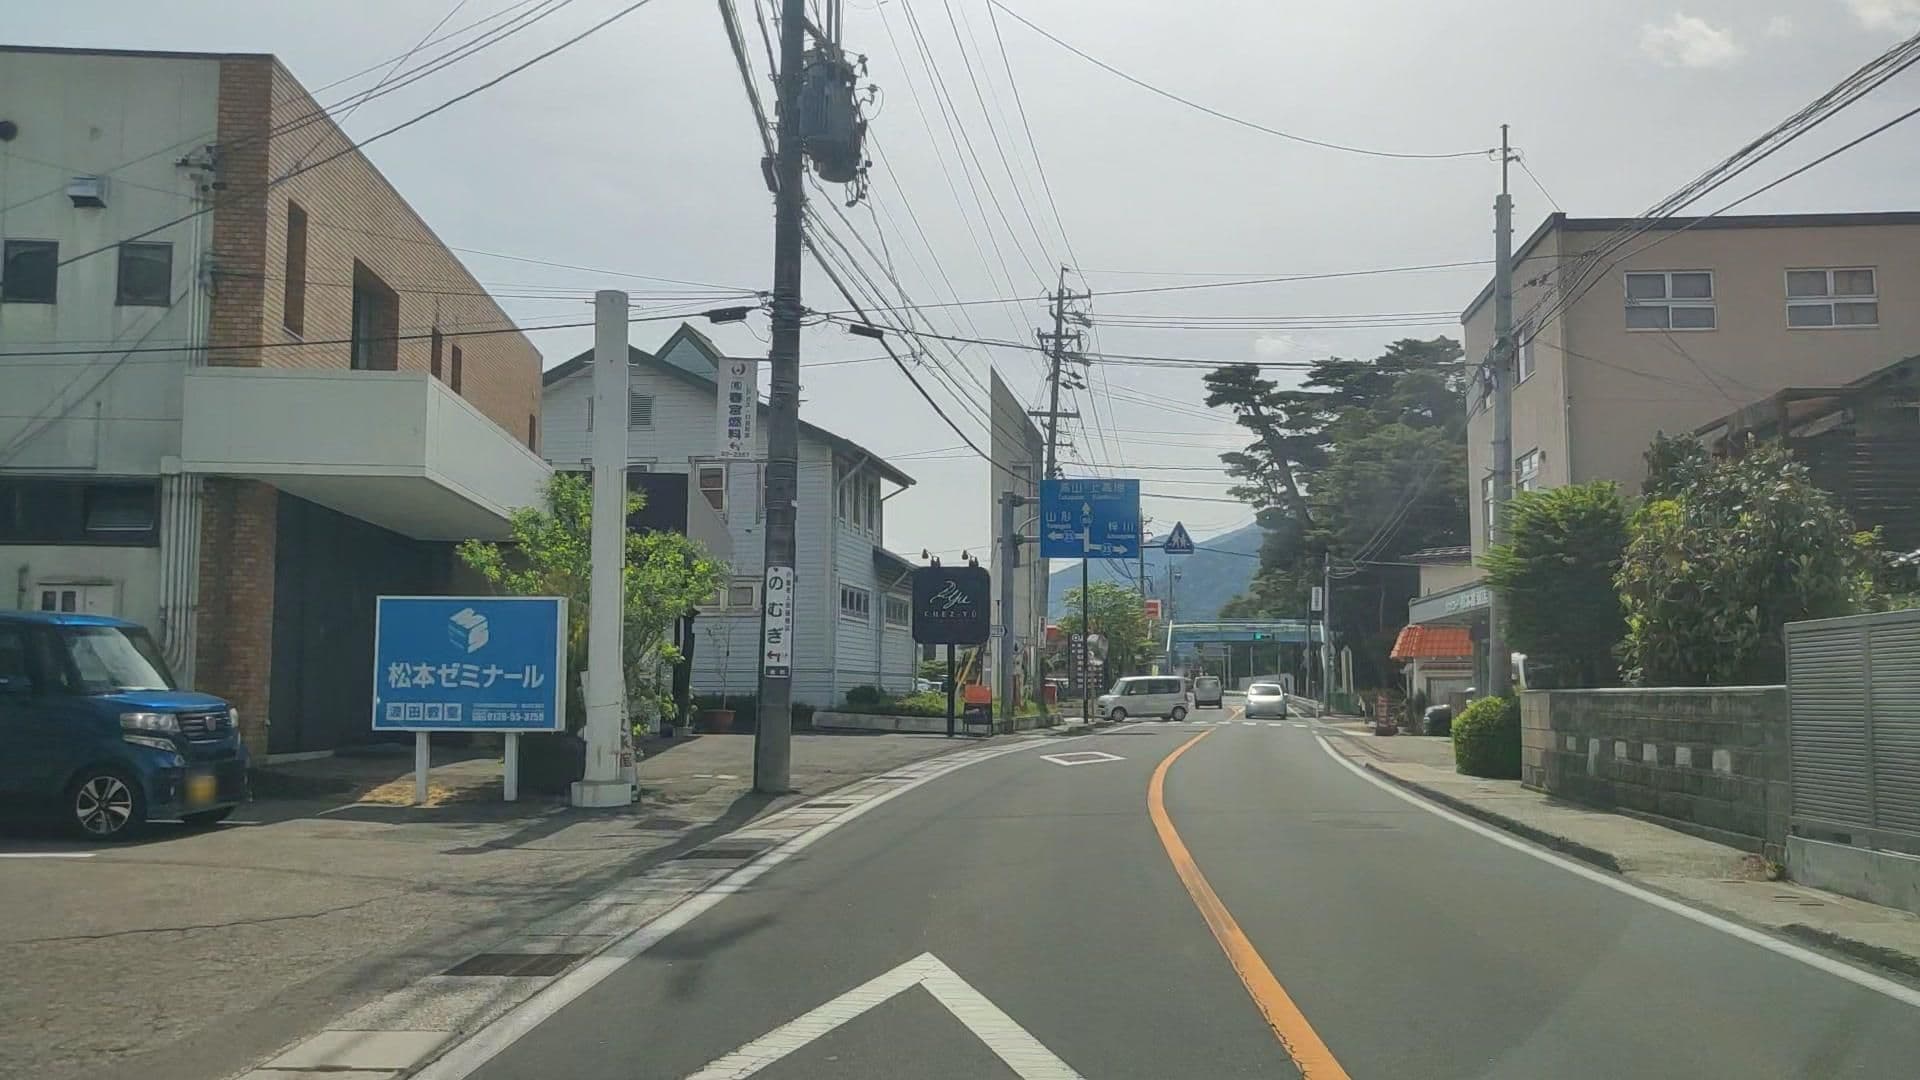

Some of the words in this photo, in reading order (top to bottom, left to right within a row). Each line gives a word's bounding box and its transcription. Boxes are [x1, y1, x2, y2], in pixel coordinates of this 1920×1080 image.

[768, 576, 785, 644] のむぎ
[387, 661, 545, 689] 松本ゼミナール
